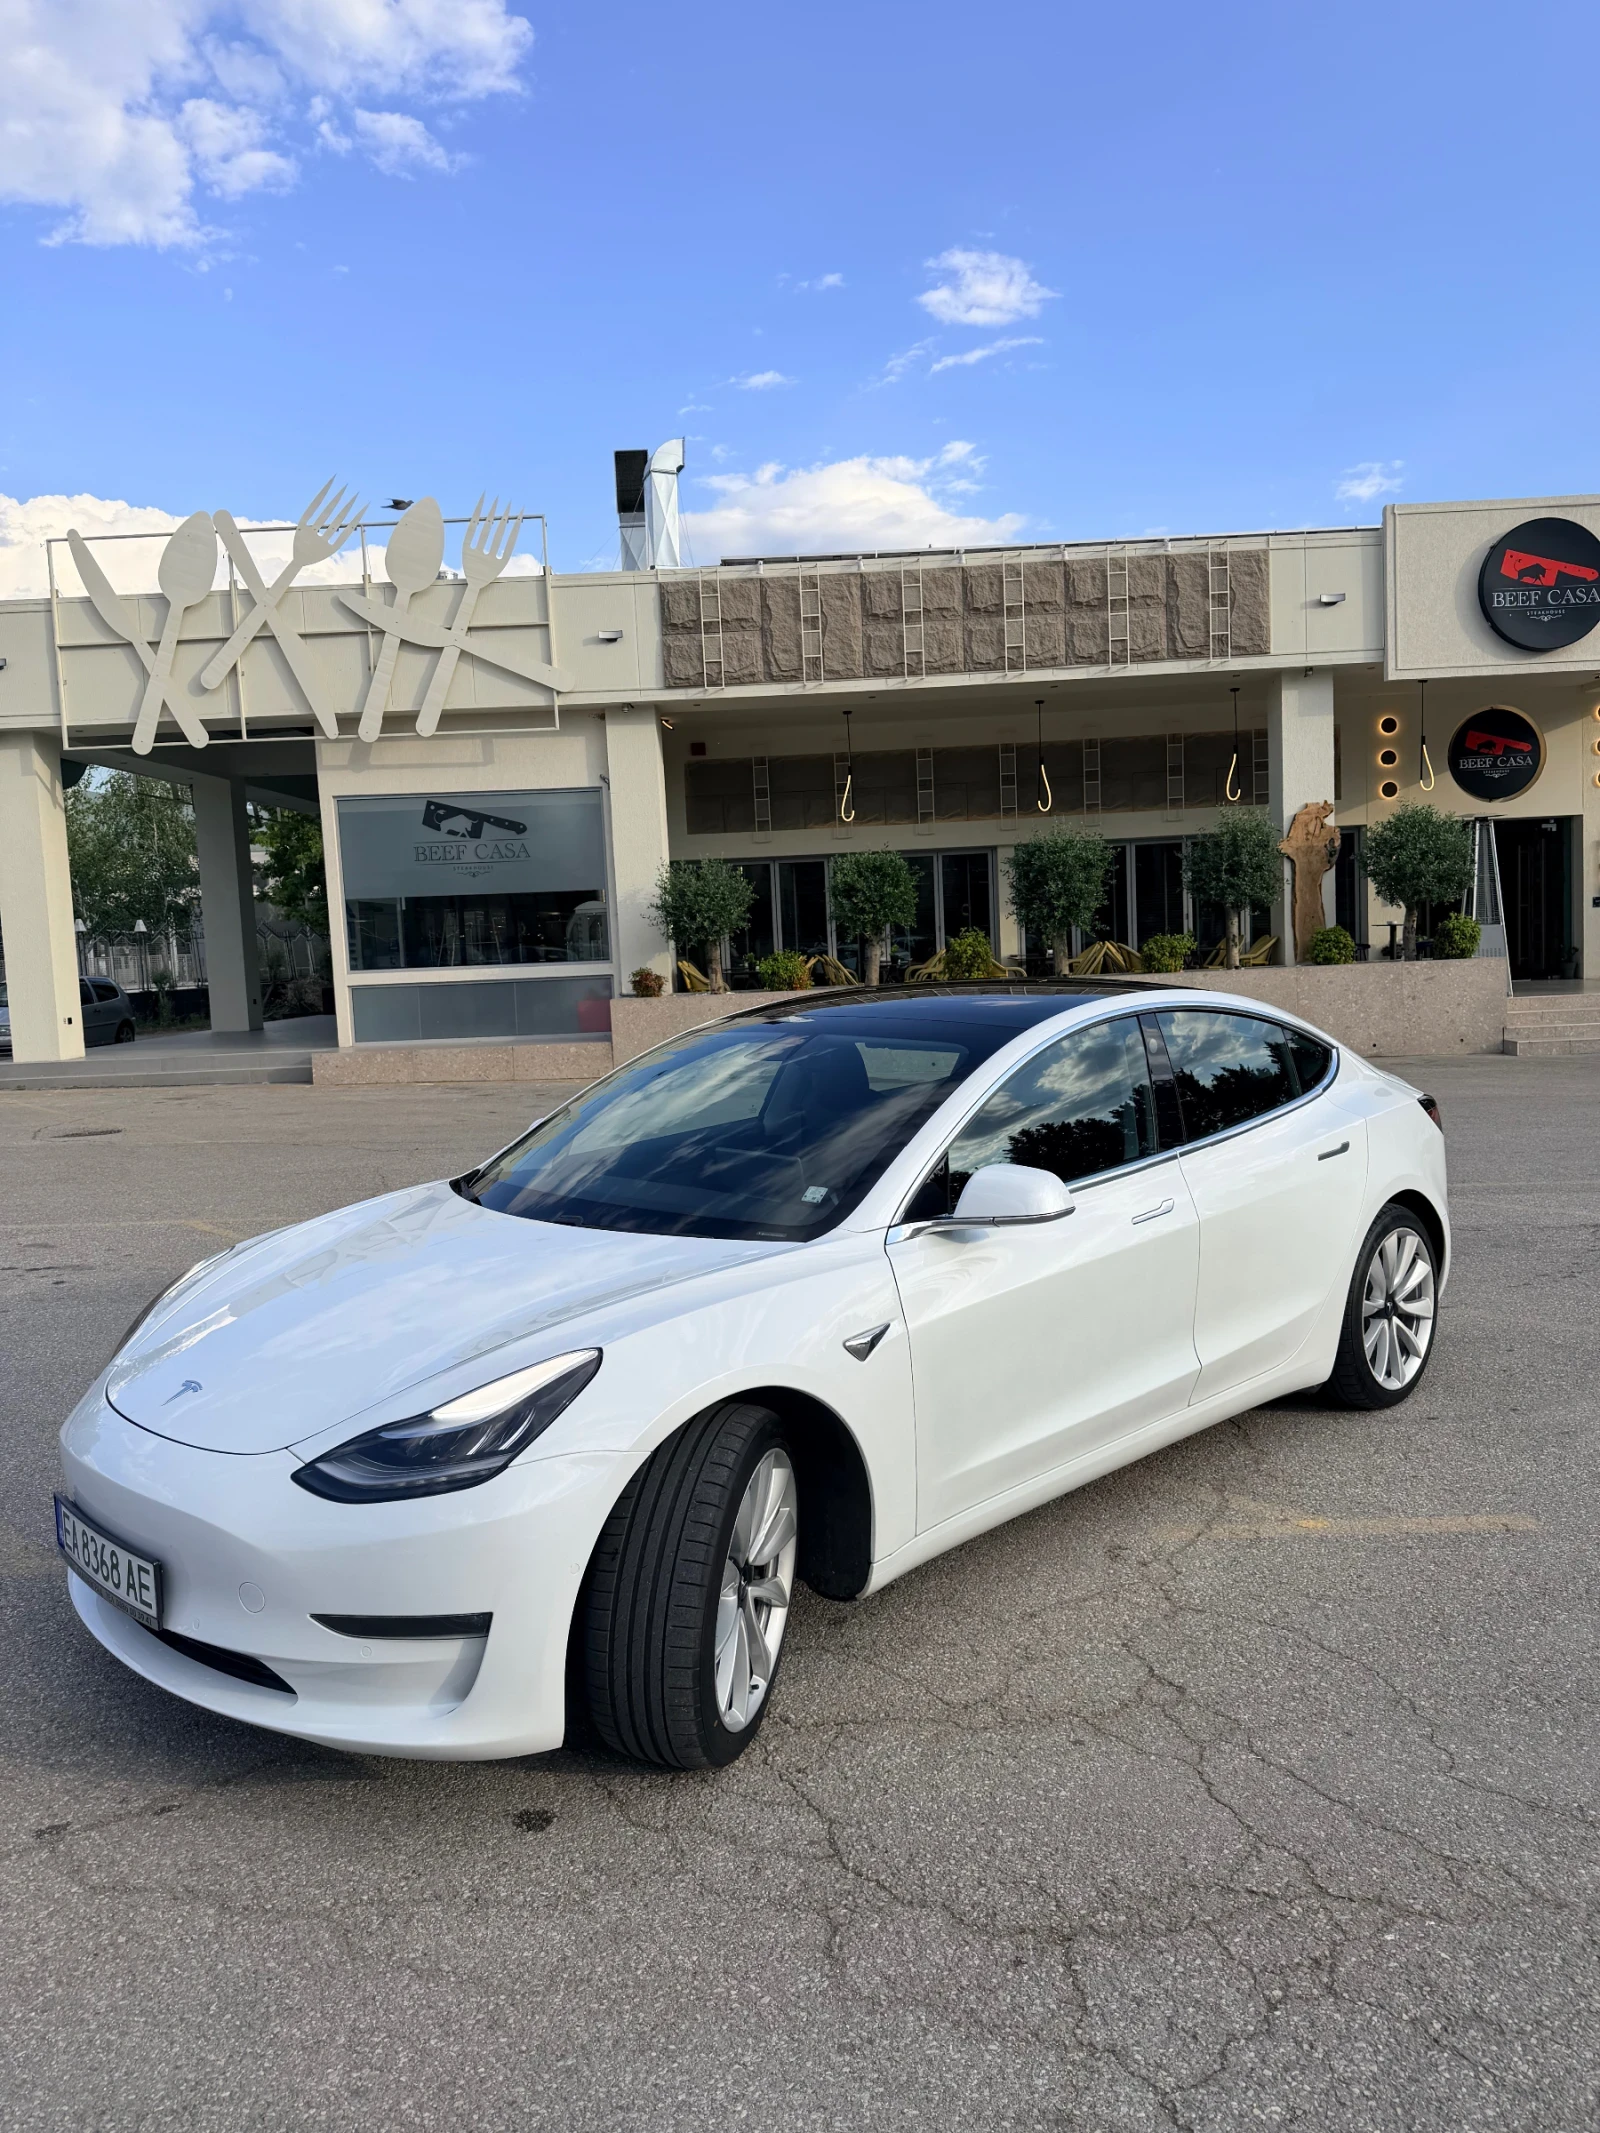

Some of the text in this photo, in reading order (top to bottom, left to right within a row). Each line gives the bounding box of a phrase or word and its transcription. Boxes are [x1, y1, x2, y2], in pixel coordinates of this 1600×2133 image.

[1492, 588, 1600, 607] BEEF CASA
[1459, 756, 1533, 769] BEEF CASA
[413, 842, 531, 861] BEEF CASA
[63, 1510, 80, 1560] EA
[82, 1529, 121, 1590] 8368
[126, 1558, 153, 1610] AE
[145, 1616, 152, 1626] 41
